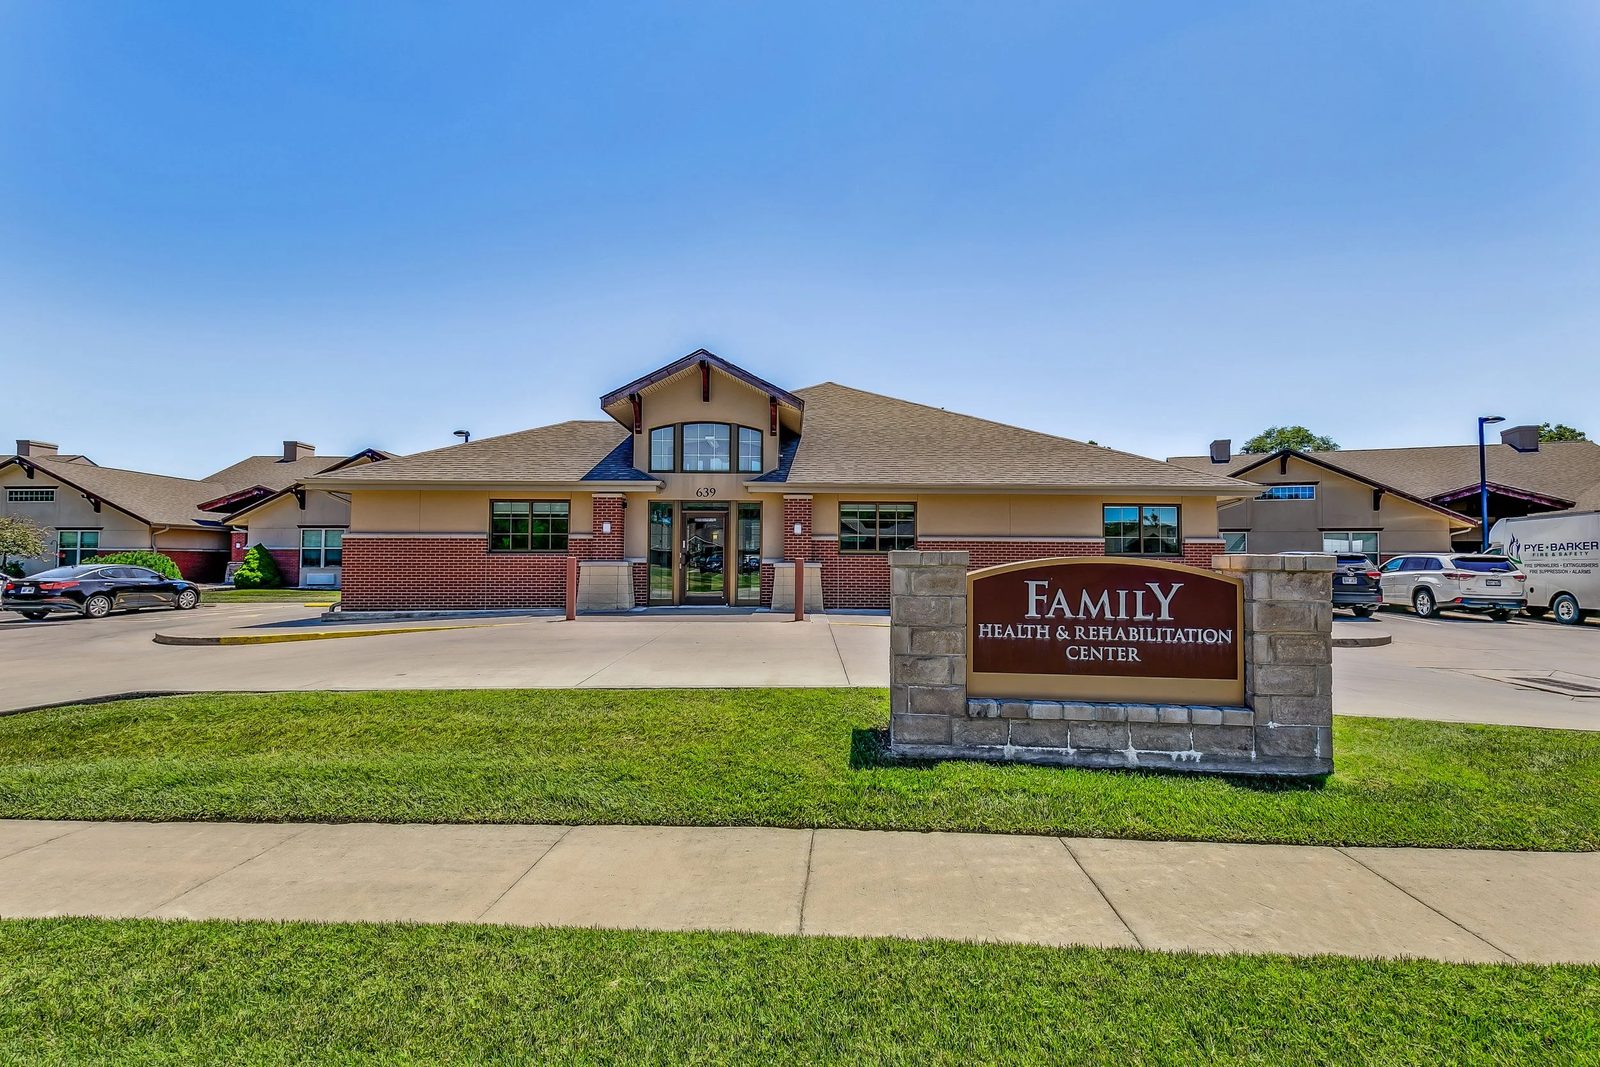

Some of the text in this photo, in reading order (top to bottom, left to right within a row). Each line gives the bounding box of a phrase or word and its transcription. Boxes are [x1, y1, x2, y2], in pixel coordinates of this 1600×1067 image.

[696, 487, 717, 498] 639
[1524, 541, 1599, 552] PYE BARKER
[1023, 580, 1185, 621] FAMILY
[978, 623, 1232, 644] HEALTH & REHABILITATION
[1065, 645, 1142, 662] CENTER
